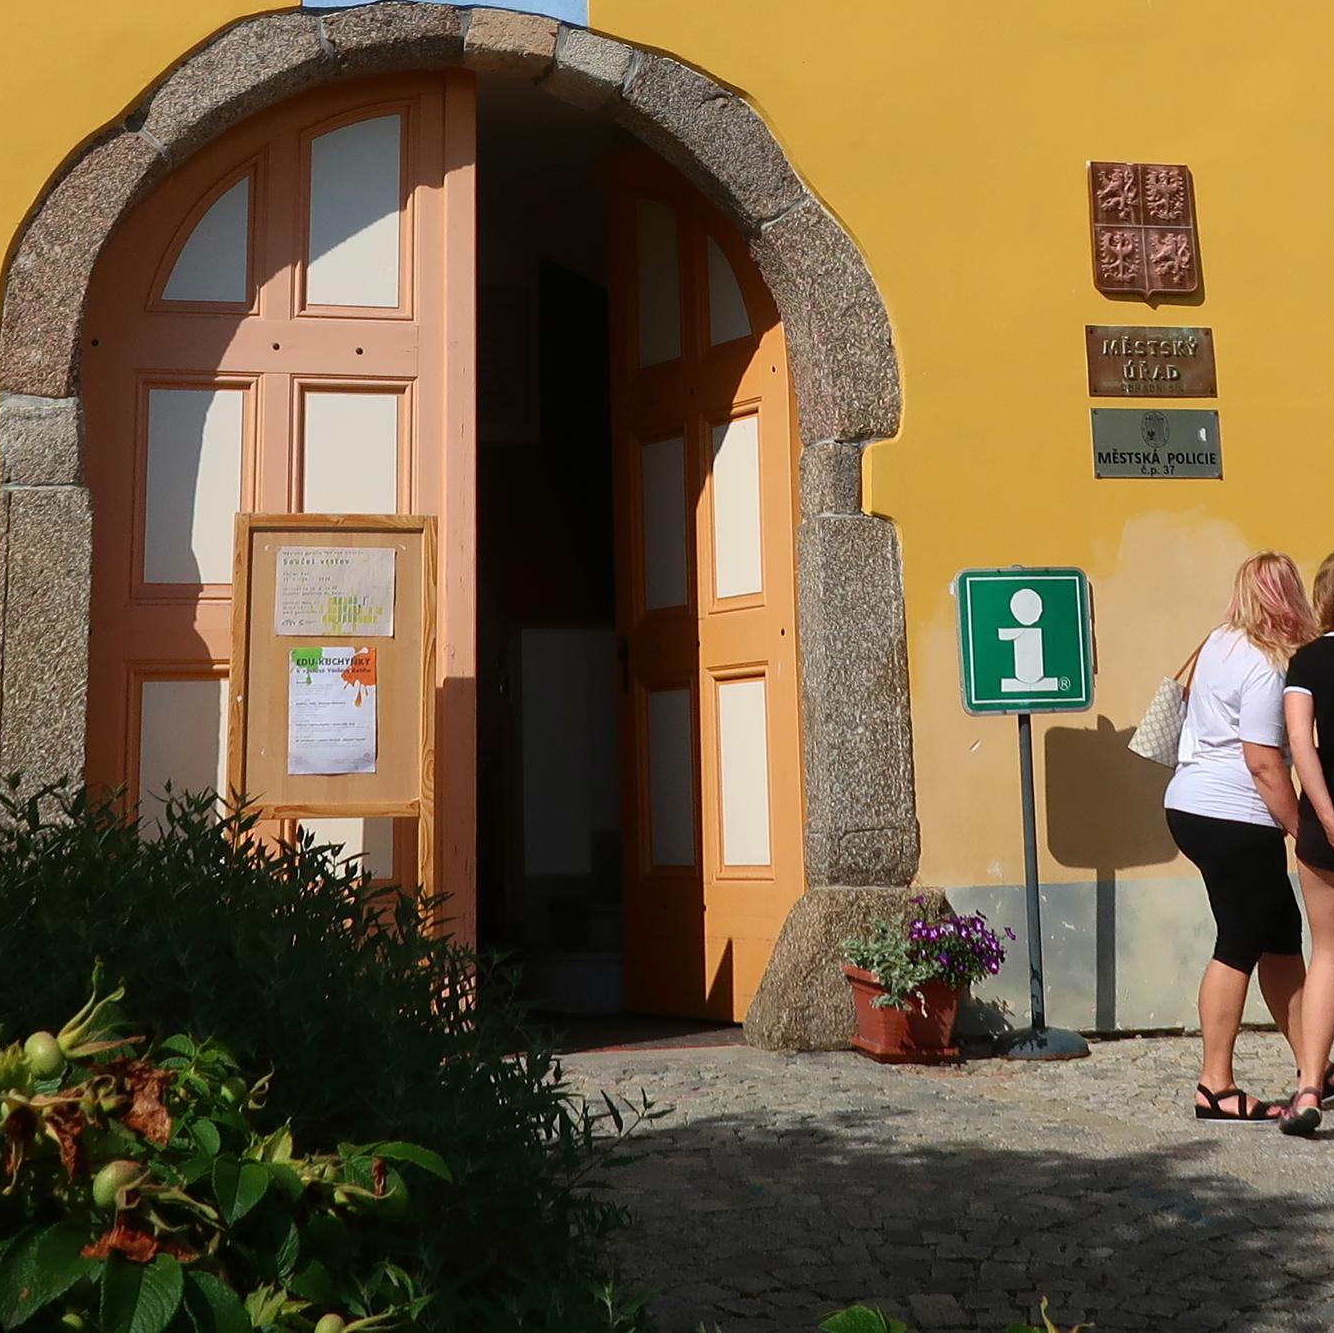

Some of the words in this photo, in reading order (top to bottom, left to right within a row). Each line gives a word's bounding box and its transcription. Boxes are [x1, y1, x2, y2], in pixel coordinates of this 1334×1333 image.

[1102, 335, 1198, 357] MĚSTSKÝ
[1123, 359, 1181, 381] ÚŘAD
[1098, 448, 1160, 464] MĚSTSKÁ
[1168, 452, 1217, 465] POLICIE
[1141, 465, 1160, 476] č.p.
[1163, 465, 1175, 475] 37
